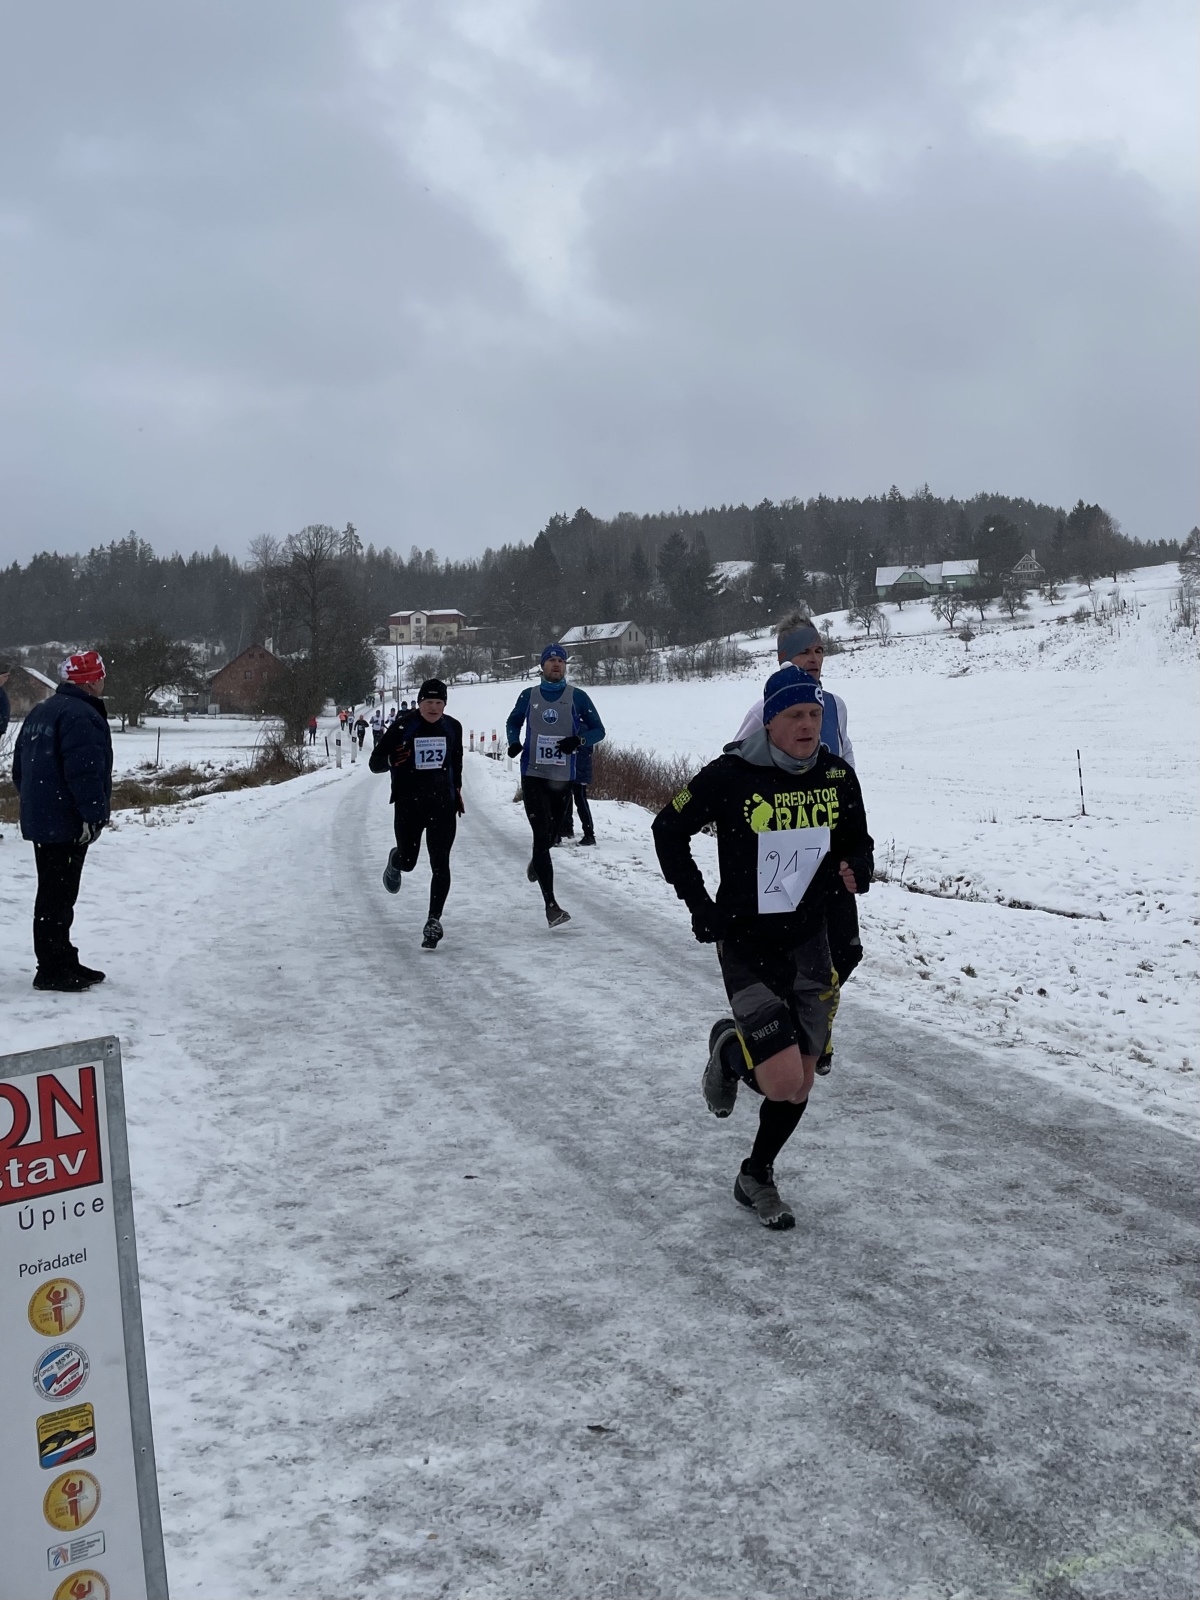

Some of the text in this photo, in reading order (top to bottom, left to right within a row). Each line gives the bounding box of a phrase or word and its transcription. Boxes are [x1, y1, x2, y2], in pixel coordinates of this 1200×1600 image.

[22, 724, 53, 737] NIKE
[419, 749, 444, 763] 123
[539, 747, 563, 759] 184
[825, 769, 846, 779] SWEEP
[774, 787, 838, 807] PREDATOR
[775, 802, 840, 830] RACE
[764, 847, 822, 894] 217
[751, 1020, 780, 1041] SWEEP
[18, 1197, 105, 1230] Úpice
[19, 1248, 87, 1277] Pořadatel
